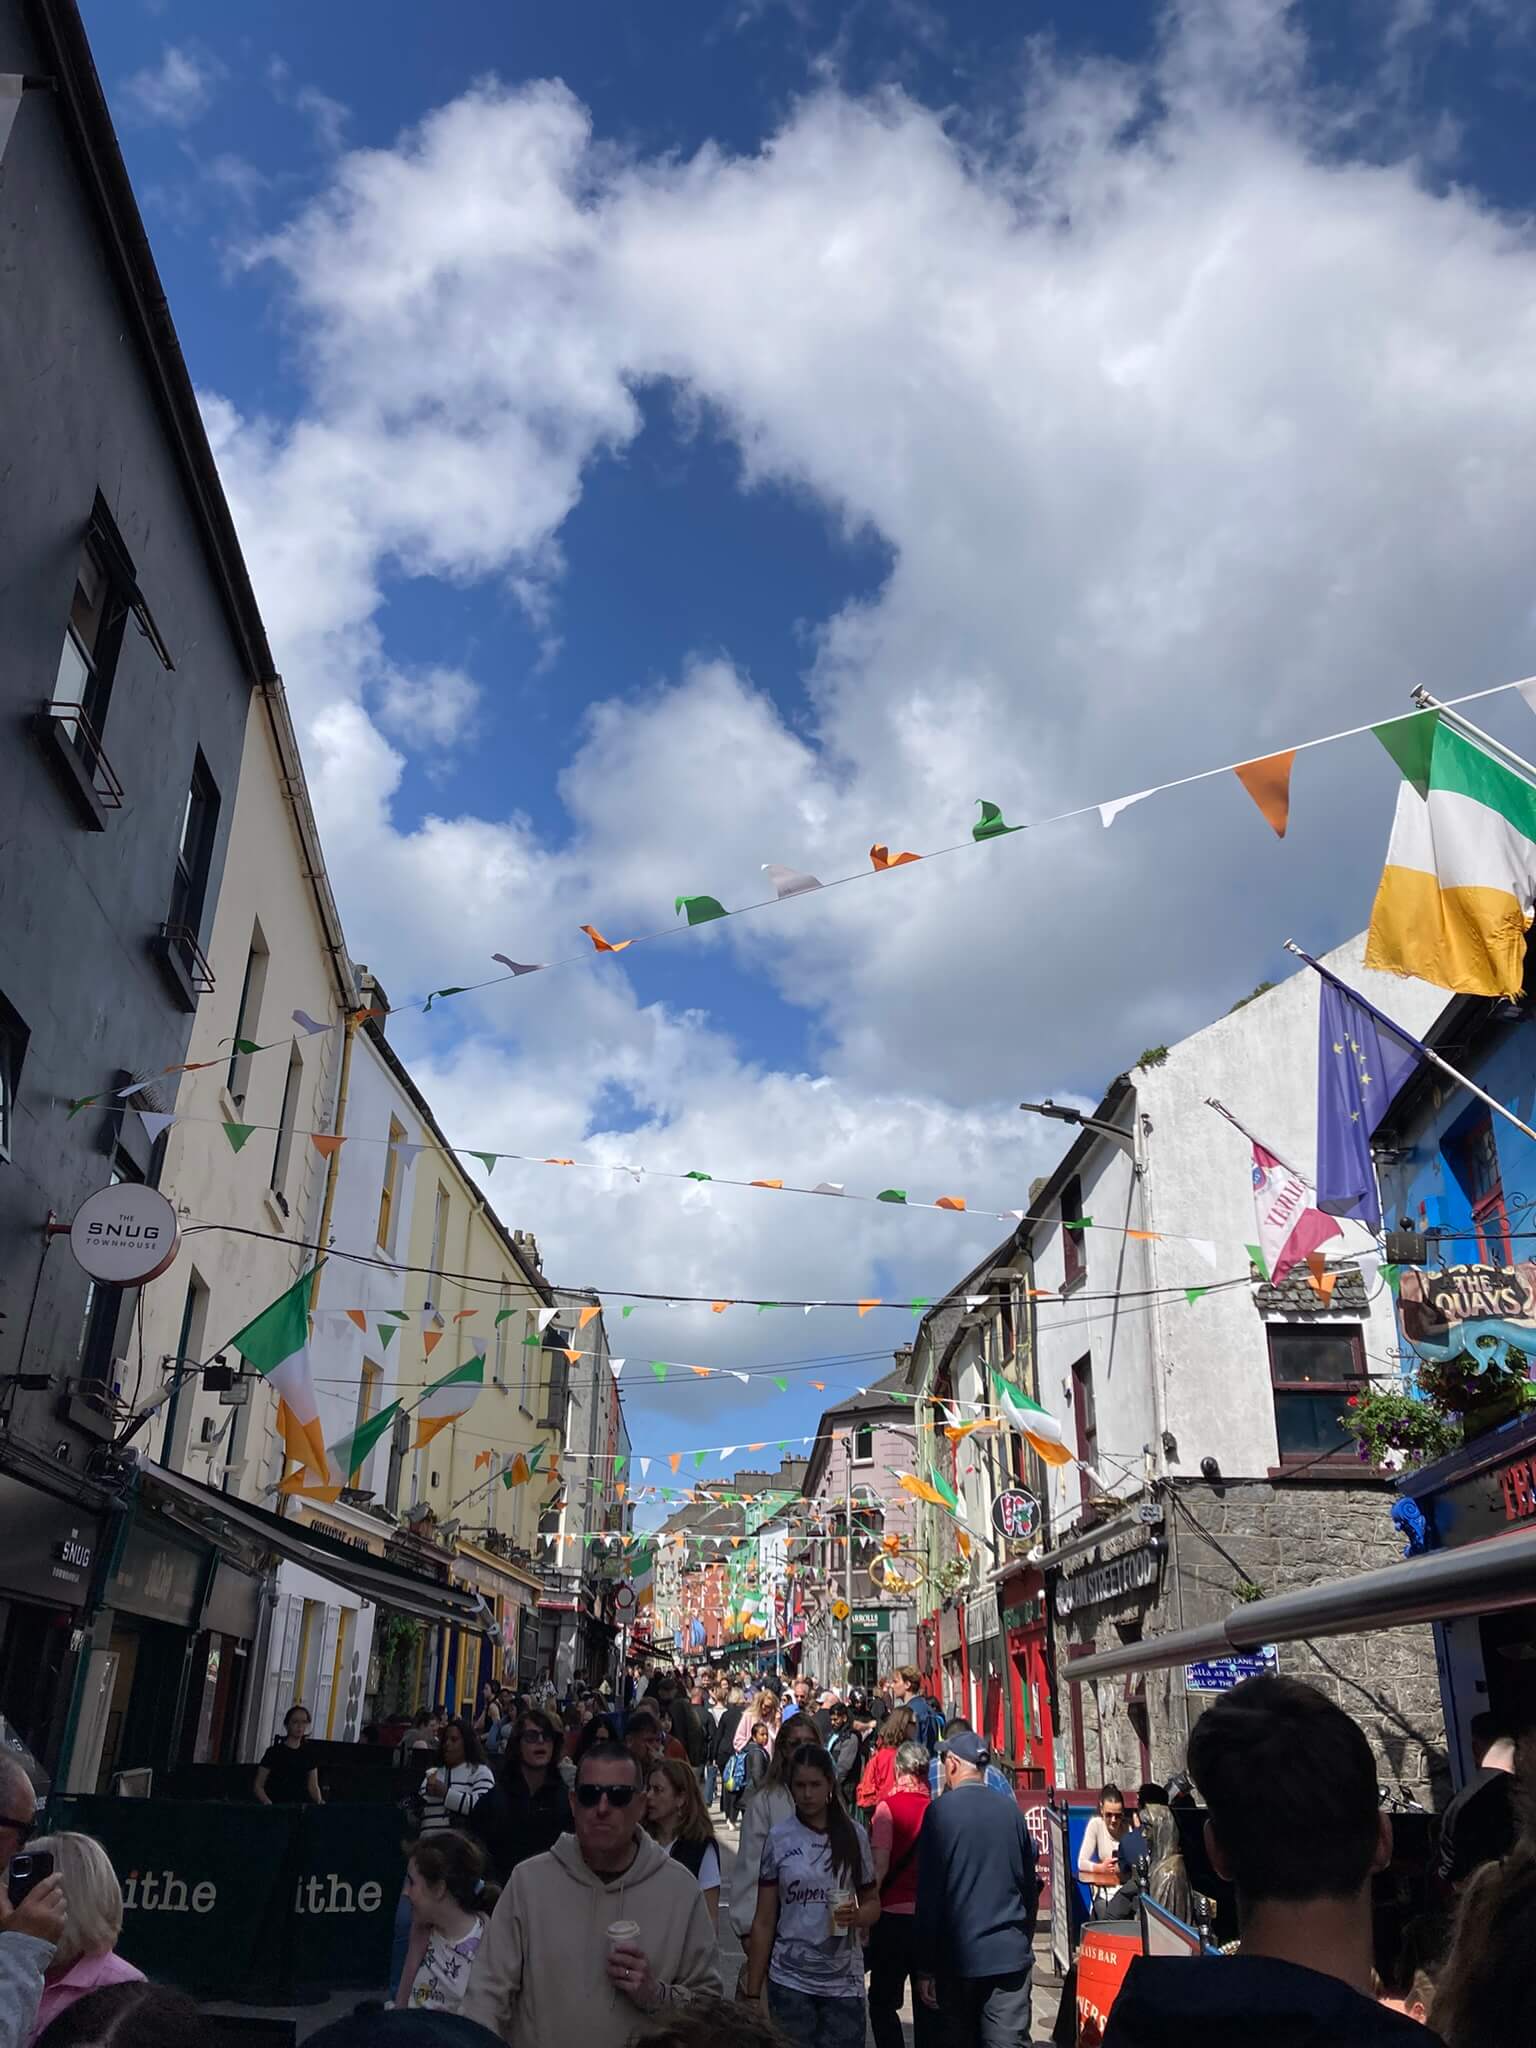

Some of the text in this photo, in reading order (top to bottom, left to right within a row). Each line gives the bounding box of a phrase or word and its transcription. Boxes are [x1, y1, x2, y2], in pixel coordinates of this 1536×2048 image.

[119, 1214, 135, 1222] THE
[88, 1222, 160, 1239] SNUG
[86, 1238, 156, 1250] TOWNHOUSE
[1453, 1274, 1494, 1293] THE
[1435, 1287, 1521, 1321] QUAYS
[62, 1541, 90, 1567] SNUG
[1088, 1561, 1122, 1604] STREET
[1123, 1549, 1151, 1590] FOOD
[1233, 1657, 1254, 1665] LANE
[1207, 1679, 1217, 1687] OF
[1219, 1679, 1233, 1687] THE
[786, 1880, 829, 1908] Super
[1098, 1950, 1117, 1965] BAR
